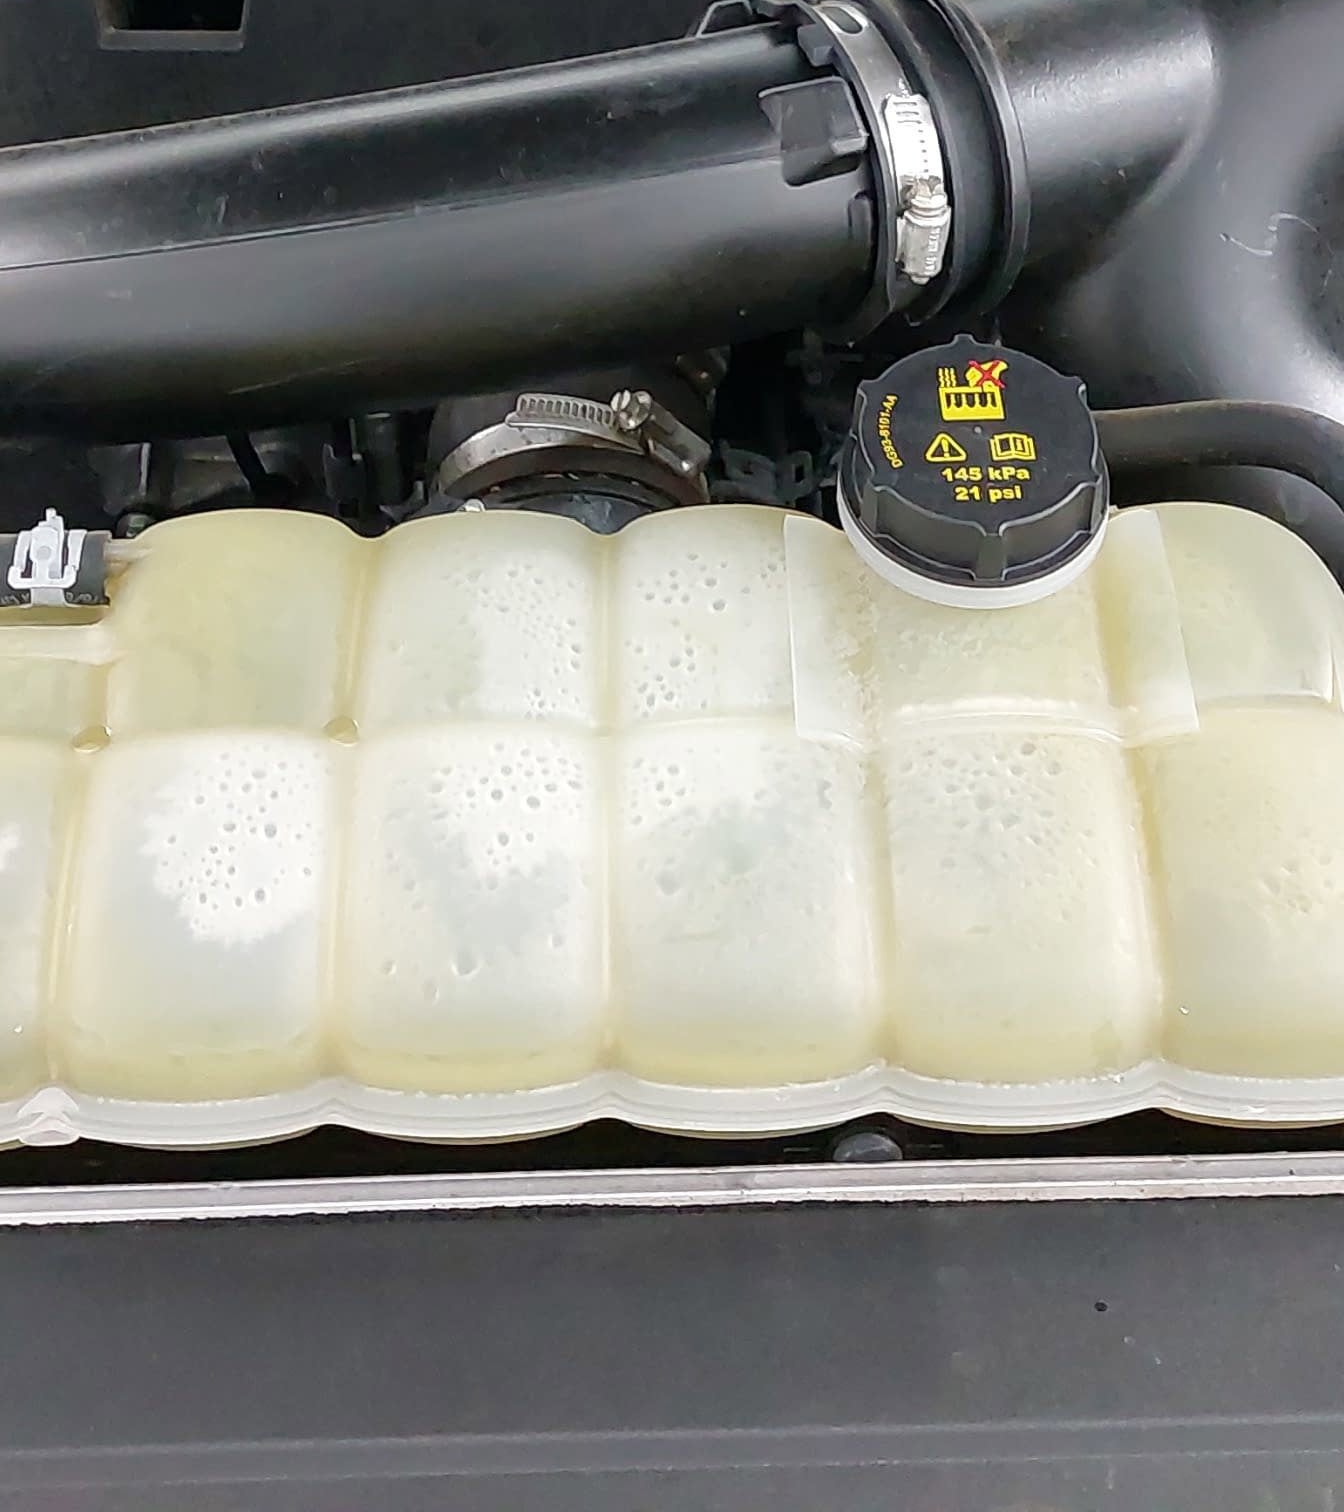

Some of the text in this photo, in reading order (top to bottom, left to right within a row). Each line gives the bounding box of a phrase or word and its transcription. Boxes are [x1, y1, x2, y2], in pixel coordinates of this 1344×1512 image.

[941, 466, 1031, 482] 145 kPa
[954, 485, 1023, 503] 21 psi
